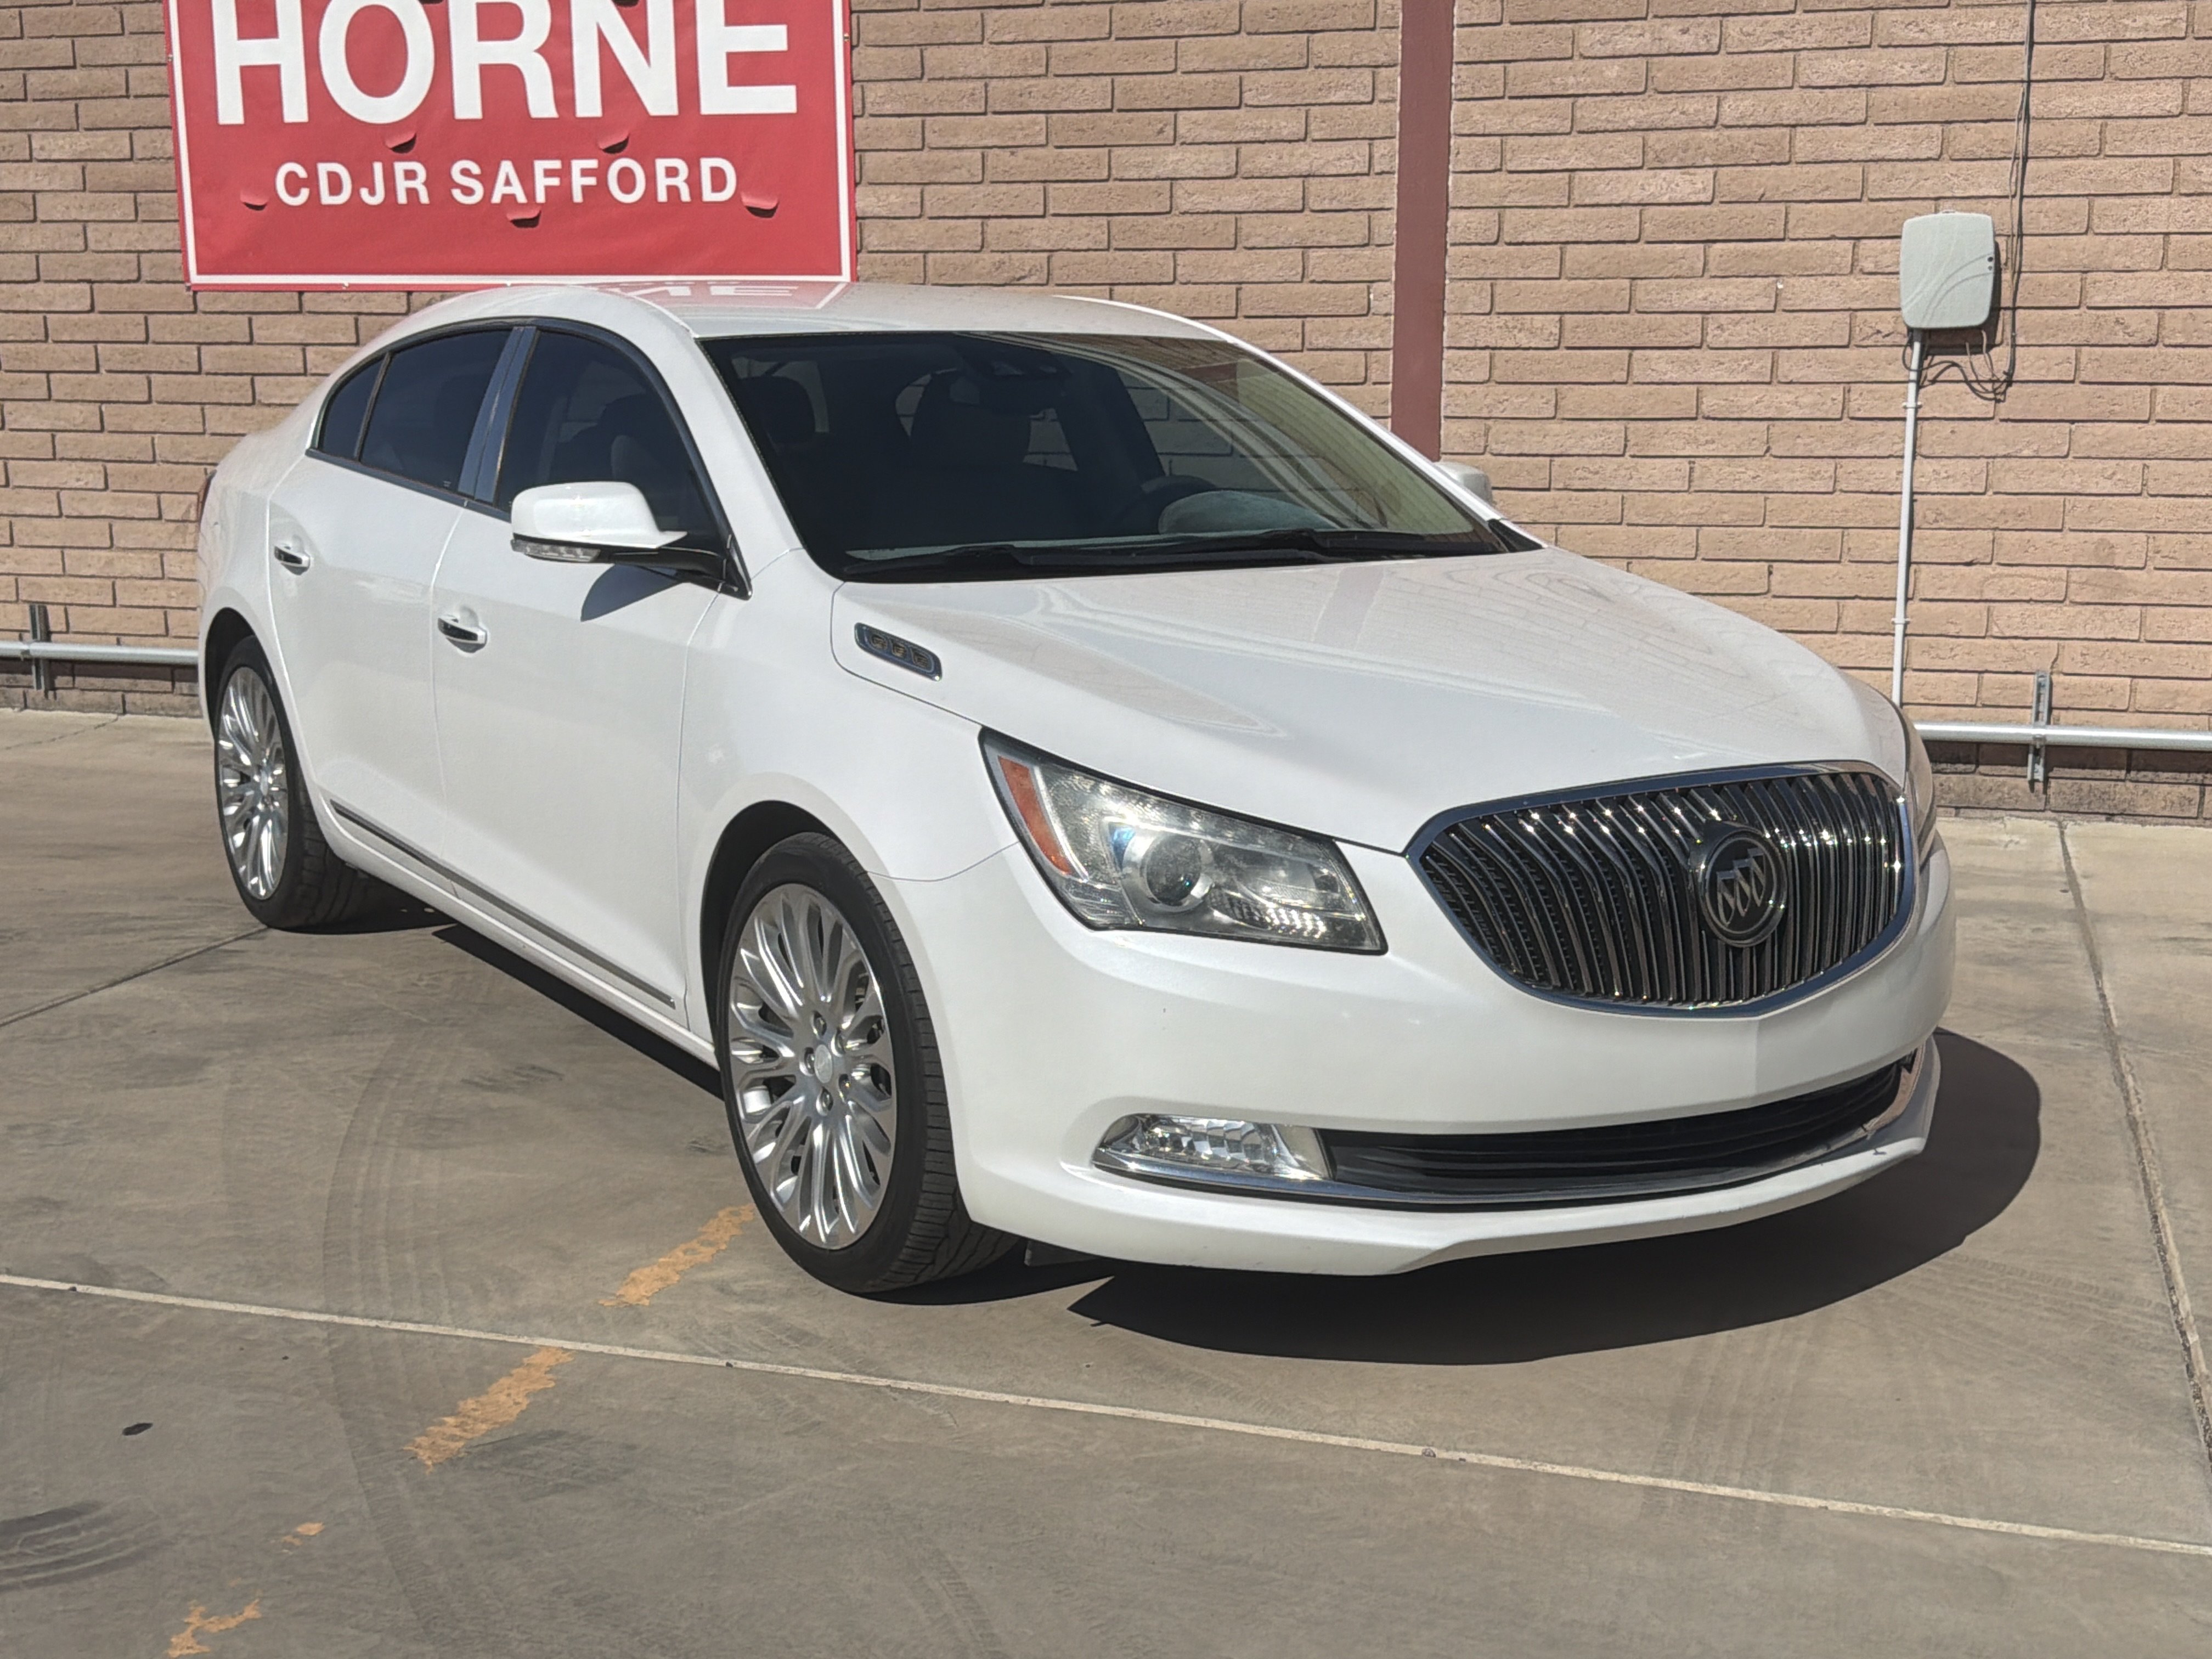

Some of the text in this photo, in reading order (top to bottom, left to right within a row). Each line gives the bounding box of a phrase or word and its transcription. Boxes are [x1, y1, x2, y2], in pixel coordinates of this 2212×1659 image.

[211, 0, 797, 125] HORNE
[275, 157, 737, 206] CDJR SAFFORD
